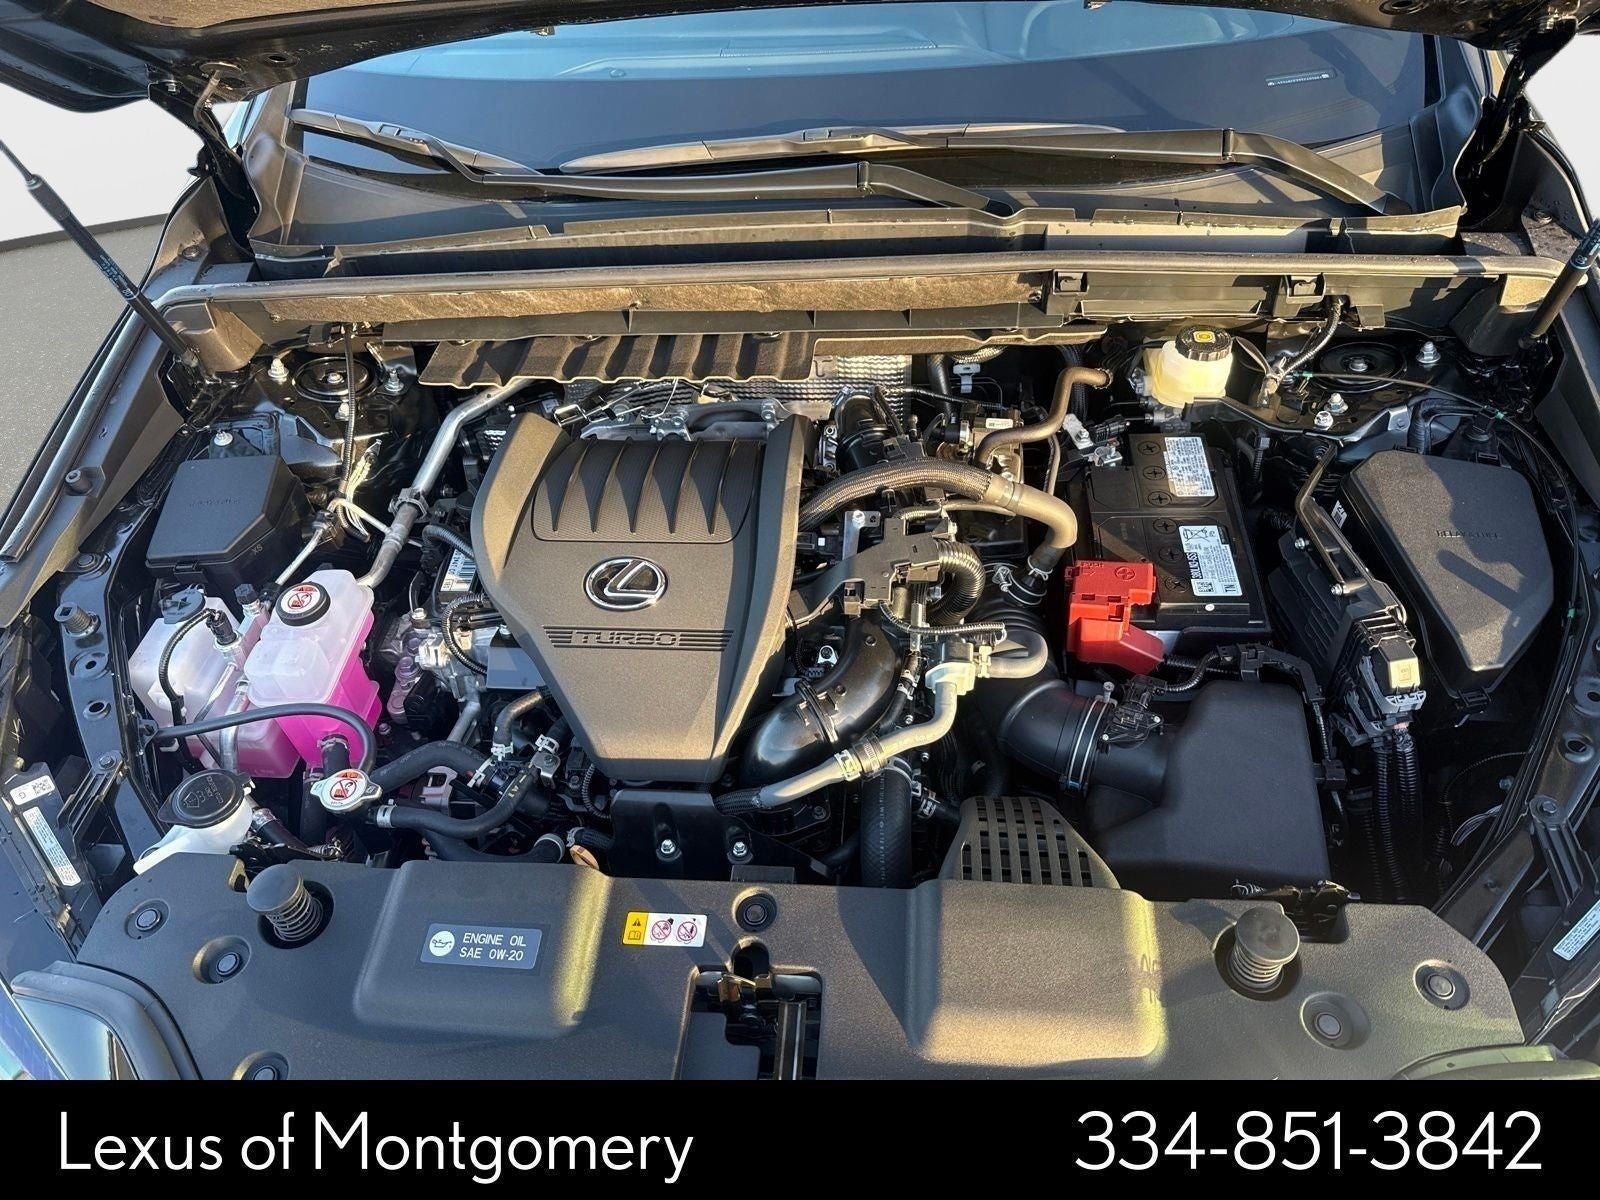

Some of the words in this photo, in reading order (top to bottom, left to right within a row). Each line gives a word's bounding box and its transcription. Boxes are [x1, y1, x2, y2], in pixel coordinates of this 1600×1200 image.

[575, 630, 676, 646] TURBO
[463, 932, 503, 945] ENGINE
[510, 935, 526, 947] OIL
[460, 947, 483, 959] SAE
[489, 949, 523, 961] 0W-20
